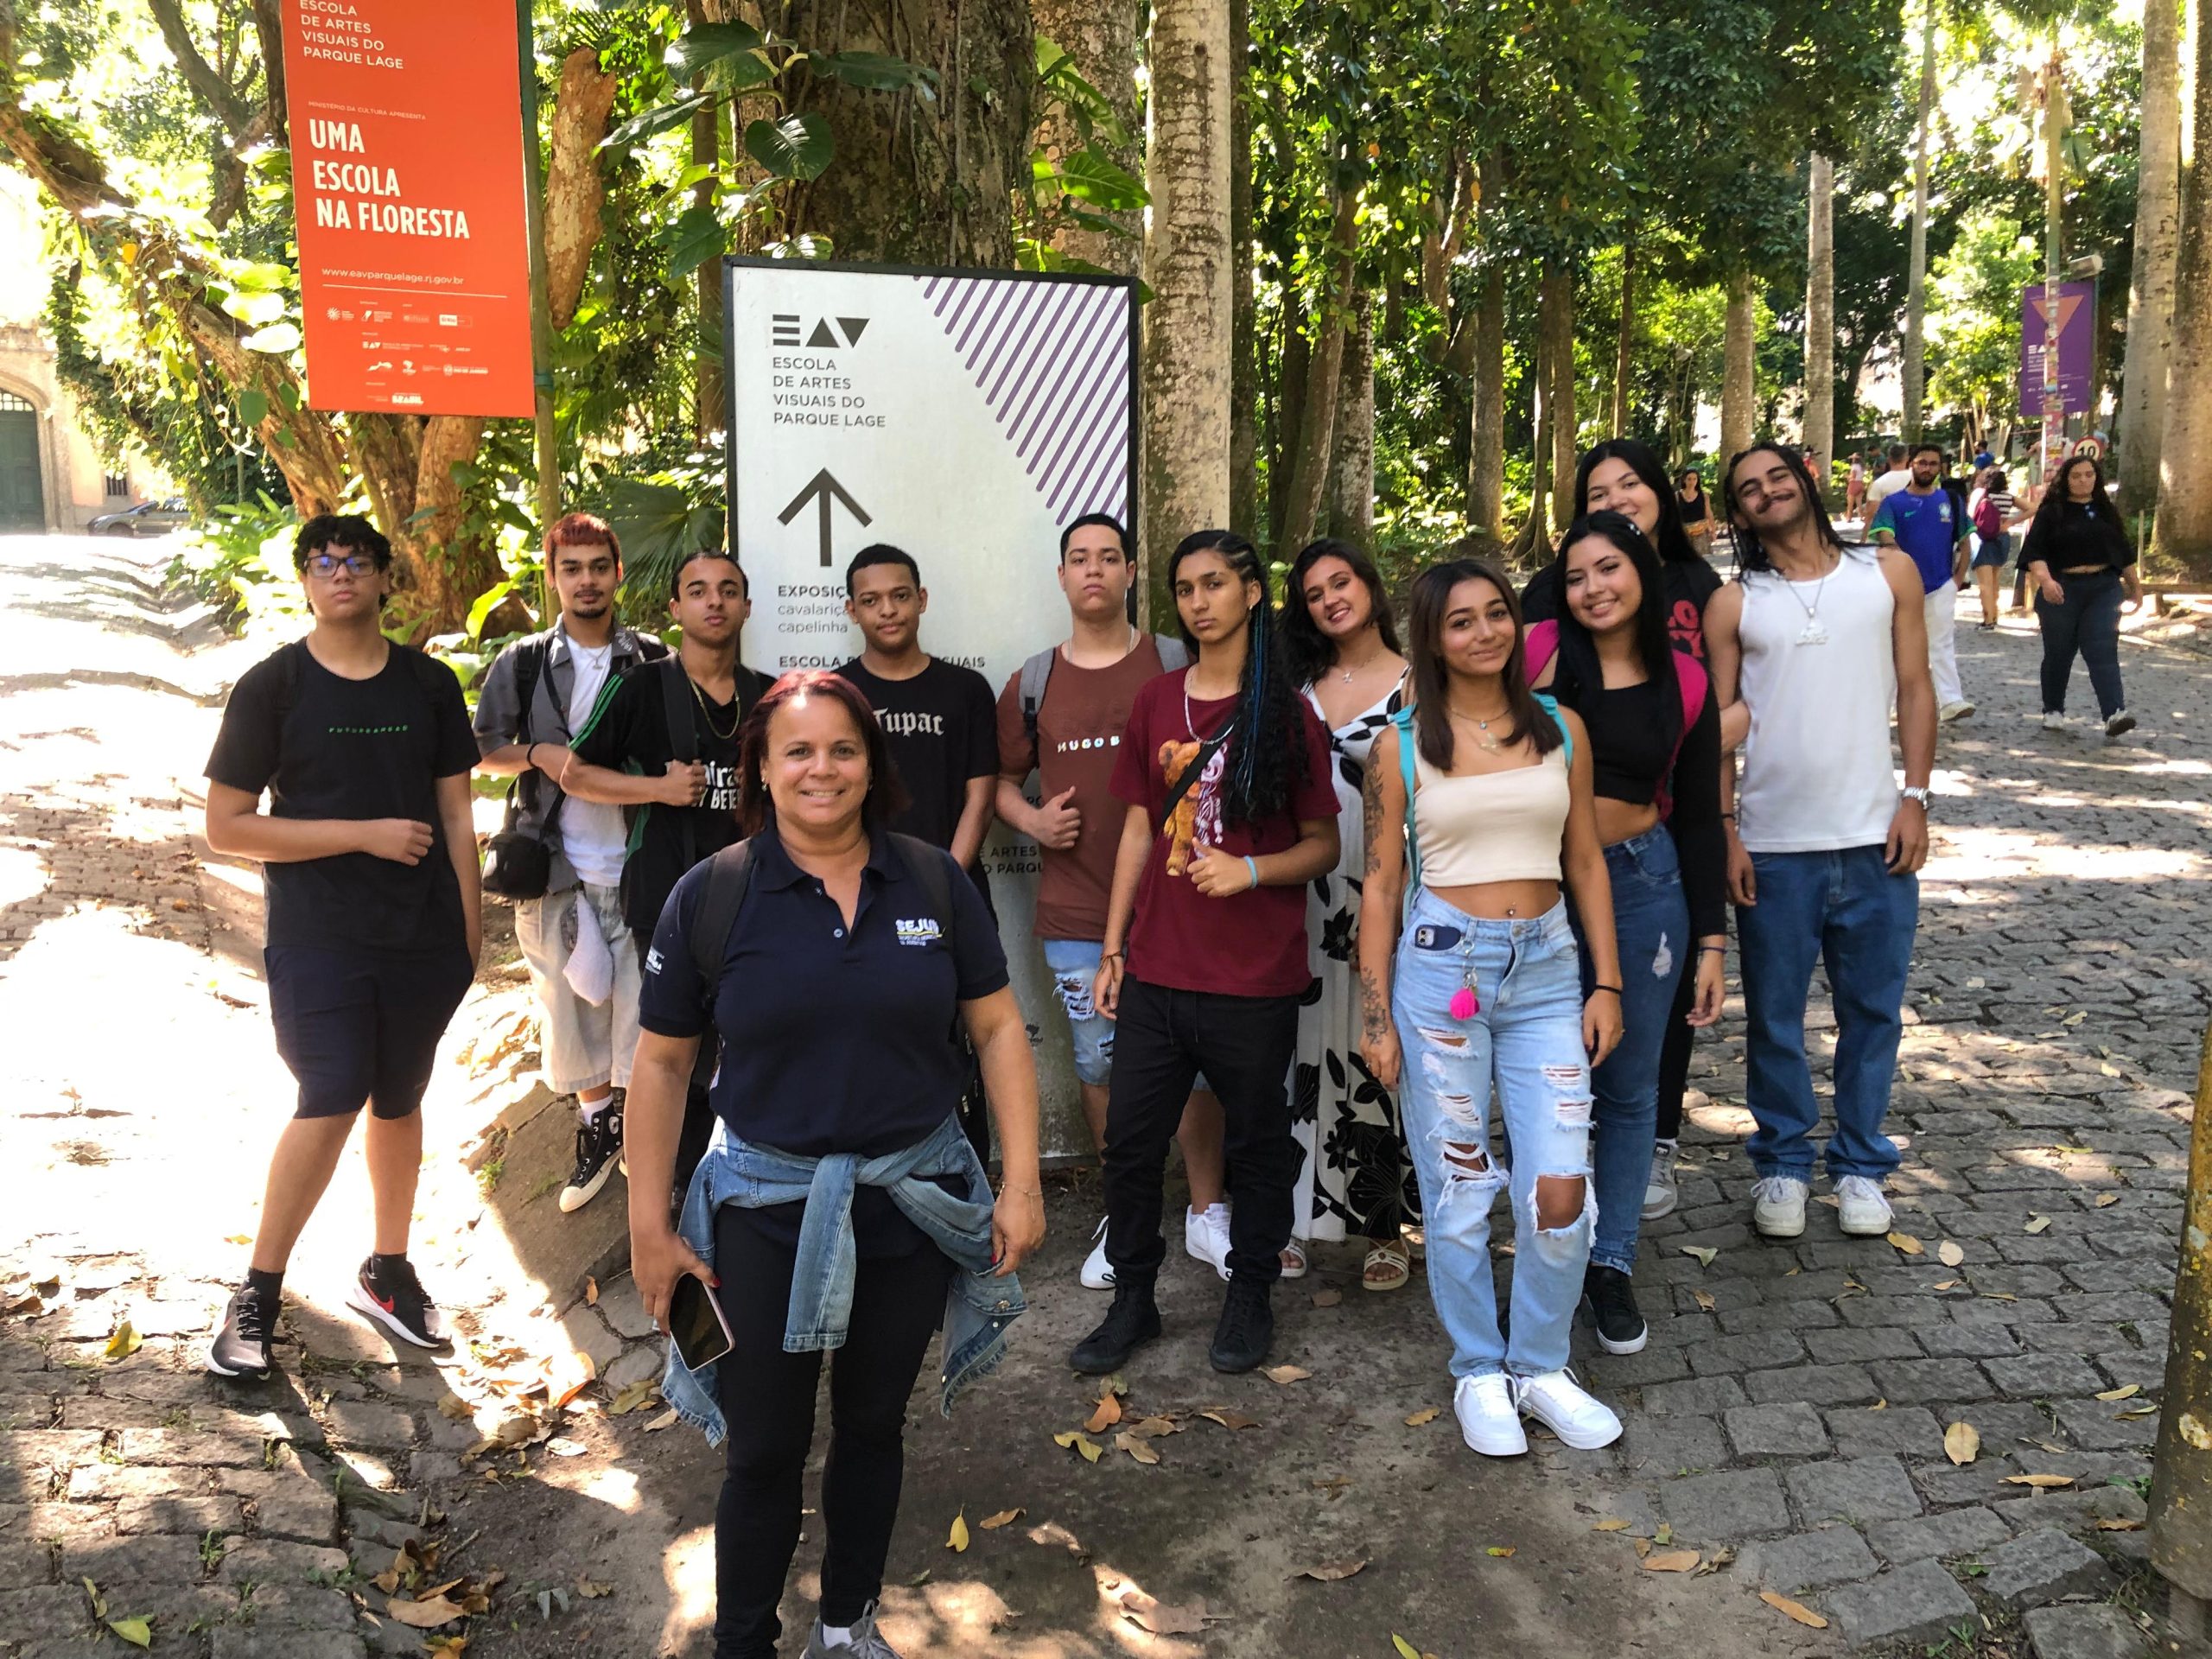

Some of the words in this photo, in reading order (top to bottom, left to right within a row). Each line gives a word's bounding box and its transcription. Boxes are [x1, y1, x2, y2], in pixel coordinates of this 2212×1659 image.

[300, 0, 357, 16] ESCOLA
[301, 14, 321, 27] DE
[326, 18, 372, 34] ARTES
[302, 29, 359, 48] VISUAIS
[363, 39, 385, 51] DO
[304, 46, 363, 64] PARQUE
[366, 55, 404, 69] LAGE
[358, 107, 387, 116] CULTURA
[389, 111, 426, 120] APRESENTA
[309, 118, 365, 153] UMA
[313, 160, 401, 197] ESCOLA
[316, 198, 352, 230] NA
[358, 202, 470, 238] FLORESTA
[321, 267, 464, 285] www.eavparquelage.rj.gov.br
[772, 357, 836, 371] ESCOLA
[773, 375, 794, 387] DE
[800, 376, 851, 390] ARTES
[773, 394, 836, 407] VISUAIS
[842, 397, 865, 409] DO
[774, 412, 839, 425] PARQUE
[845, 415, 887, 428] LAGE
[2077, 445, 2096, 458] 10
[779, 585, 845, 600] EXPOSIÇ
[778, 603, 847, 617] cavalariç
[778, 620, 848, 635] capelinha
[779, 656, 841, 668] ESCOLA
[873, 707, 945, 737] Tupac
[1057, 737, 1104, 753] HUGO
[990, 846, 1037, 857] ARTES
[997, 862, 1042, 874] PARQ
